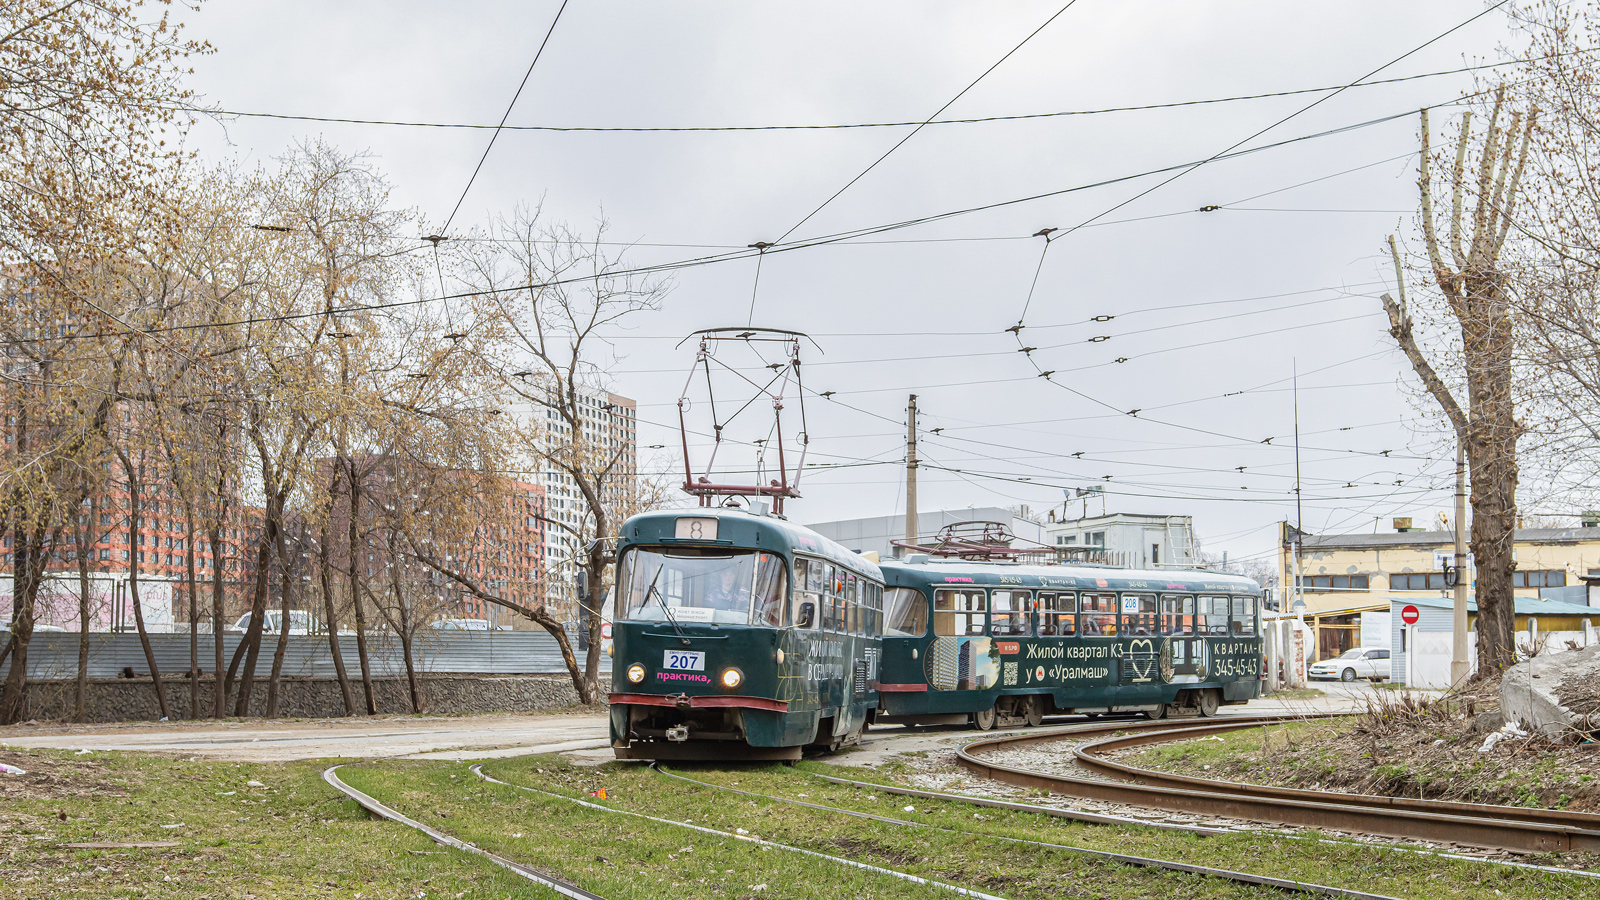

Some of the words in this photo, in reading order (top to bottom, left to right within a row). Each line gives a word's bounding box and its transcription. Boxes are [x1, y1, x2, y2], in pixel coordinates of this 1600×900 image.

[690, 520, 703, 540] 8
[1124, 598, 1137, 609] 208
[1026, 641, 1064, 659] Жилой
[1067, 646, 1108, 662] квартал
[1110, 643, 1124, 658] К3
[669, 655, 698, 669] 207
[1214, 658, 1257, 677] 345-45-43
[656, 672, 712, 685] практика,
[1025, 668, 1033, 684] у
[1048, 664, 1109, 683] «Уралмаш»
